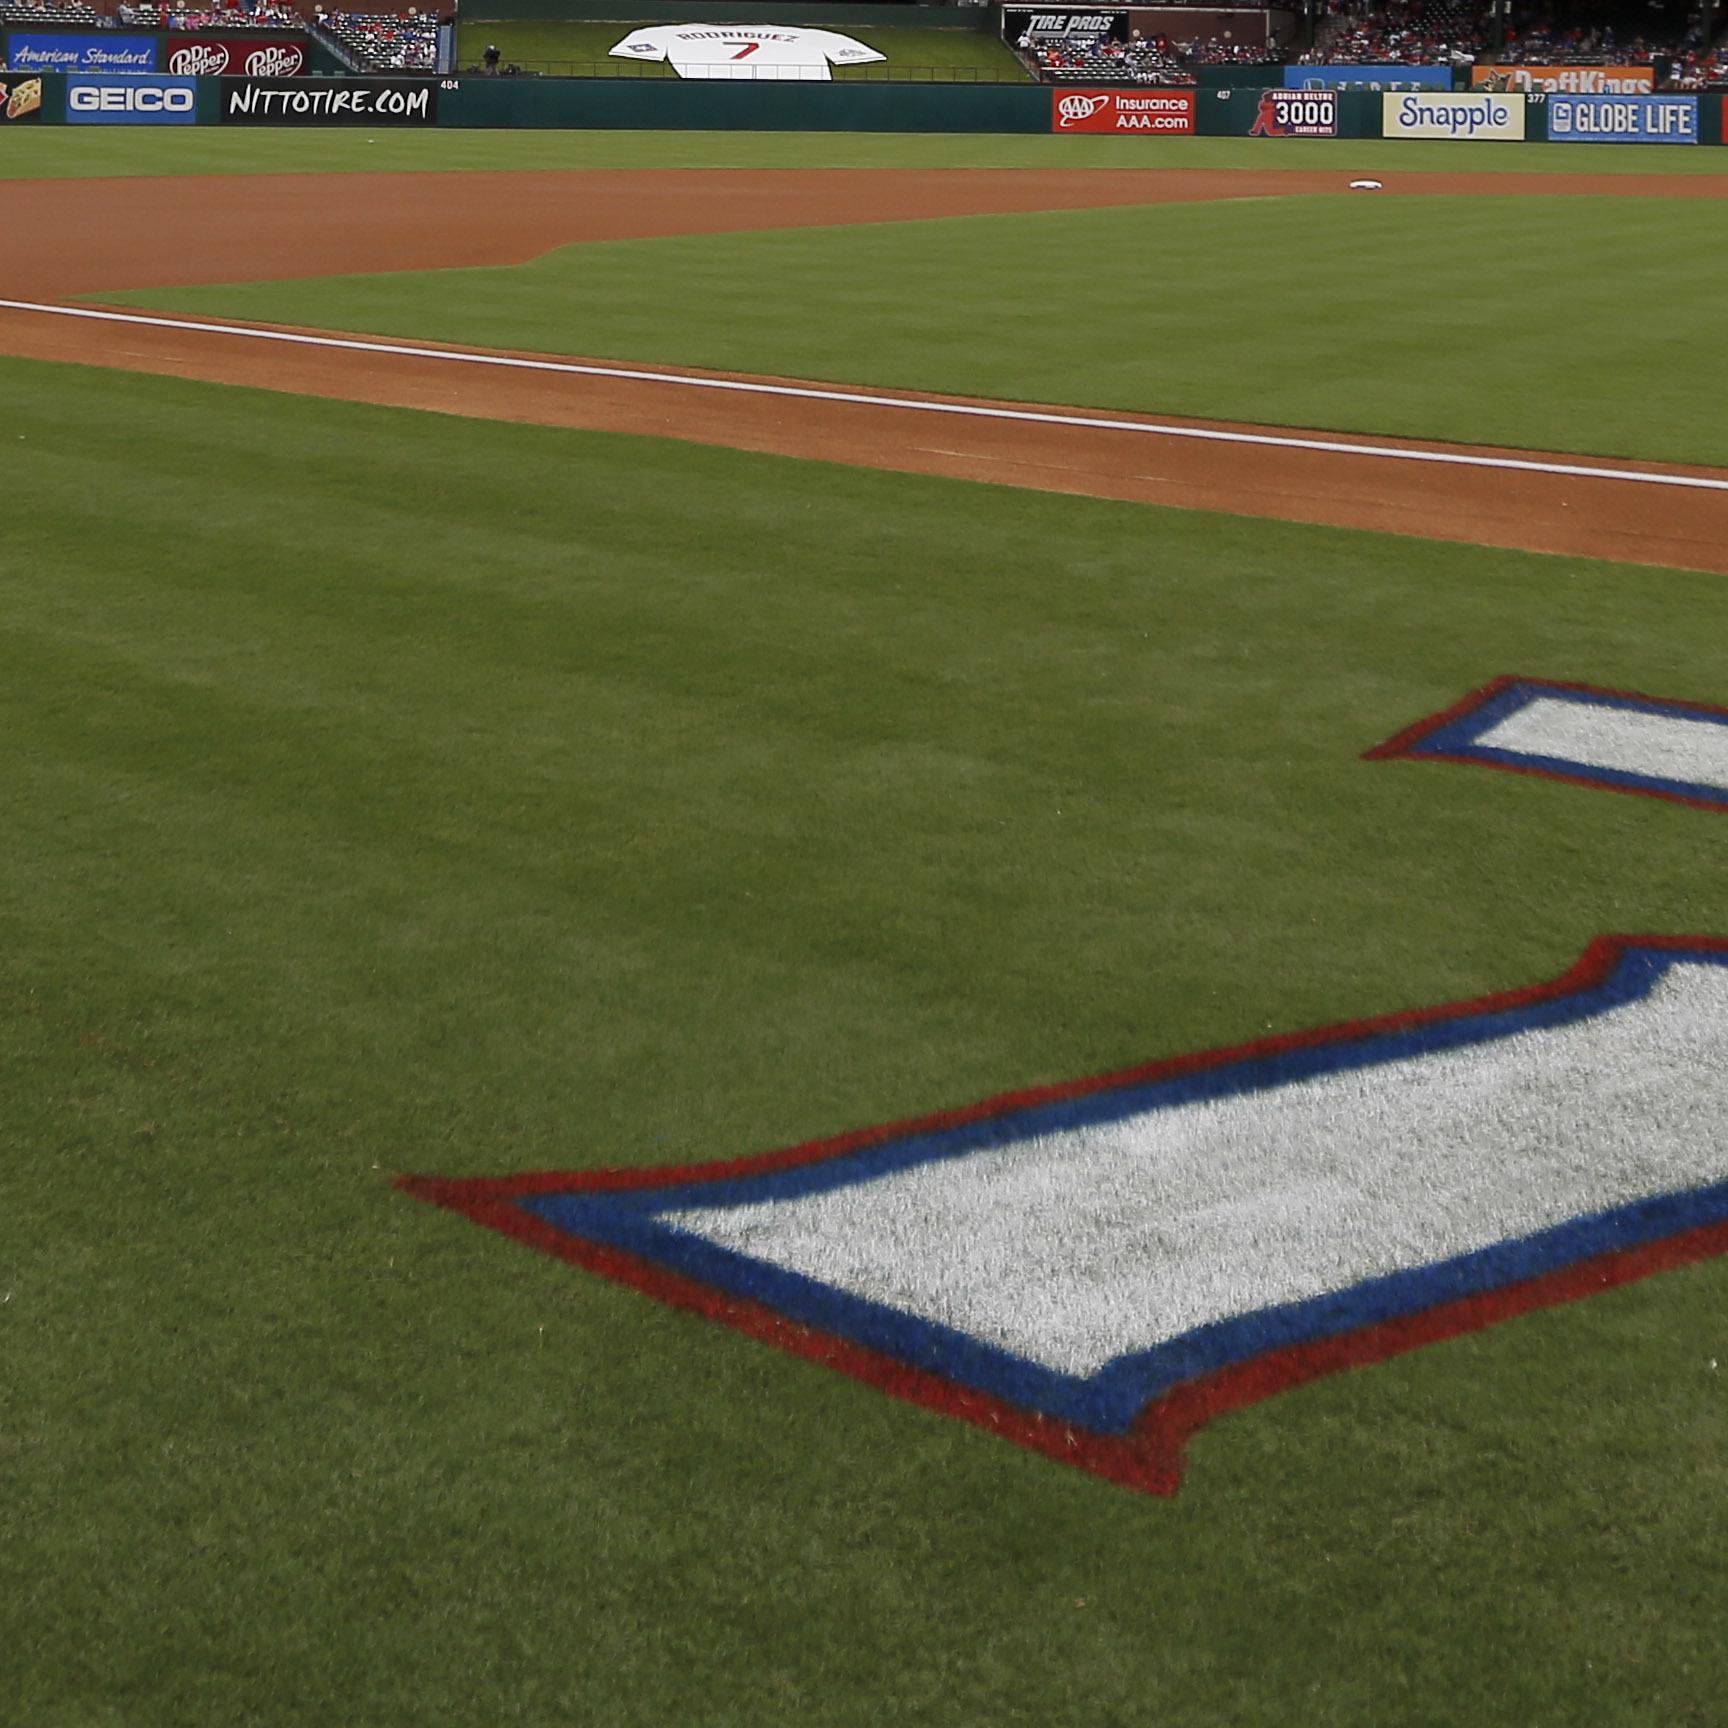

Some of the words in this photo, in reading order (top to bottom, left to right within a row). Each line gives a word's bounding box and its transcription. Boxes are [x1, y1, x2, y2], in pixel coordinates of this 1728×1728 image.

[1029, 14, 1067, 35] TIRE
[1067, 15, 1114, 35] PROS
[676, 30, 801, 44] RODRIGUEZ
[13, 44, 79, 65] American
[80, 45, 150, 65] Standard
[174, 48, 224, 74] Pepper
[191, 45, 212, 60] Dr
[265, 46, 287, 62] Dr
[722, 41, 760, 61] 7
[249, 50, 299, 75] Pepper
[440, 80, 459, 90] 404
[1515, 70, 1653, 94] DraftKings
[69, 86, 195, 112] GEICO
[229, 84, 429, 119] NITTOTIRE.COM
[1116, 96, 1189, 111] Insurance
[1217, 90, 1230, 100] 407
[1272, 92, 1302, 101] ADRIAN
[1303, 92, 1333, 101] BELTRE
[1527, 93, 1546, 104] 377
[1061, 98, 1091, 117] AAA
[1276, 101, 1334, 125] 3000
[1399, 96, 1508, 135] Snapple
[1116, 114, 1189, 130] AAA.com
[1575, 103, 1640, 134] GLOBE
[1646, 103, 1693, 135] LIFE
